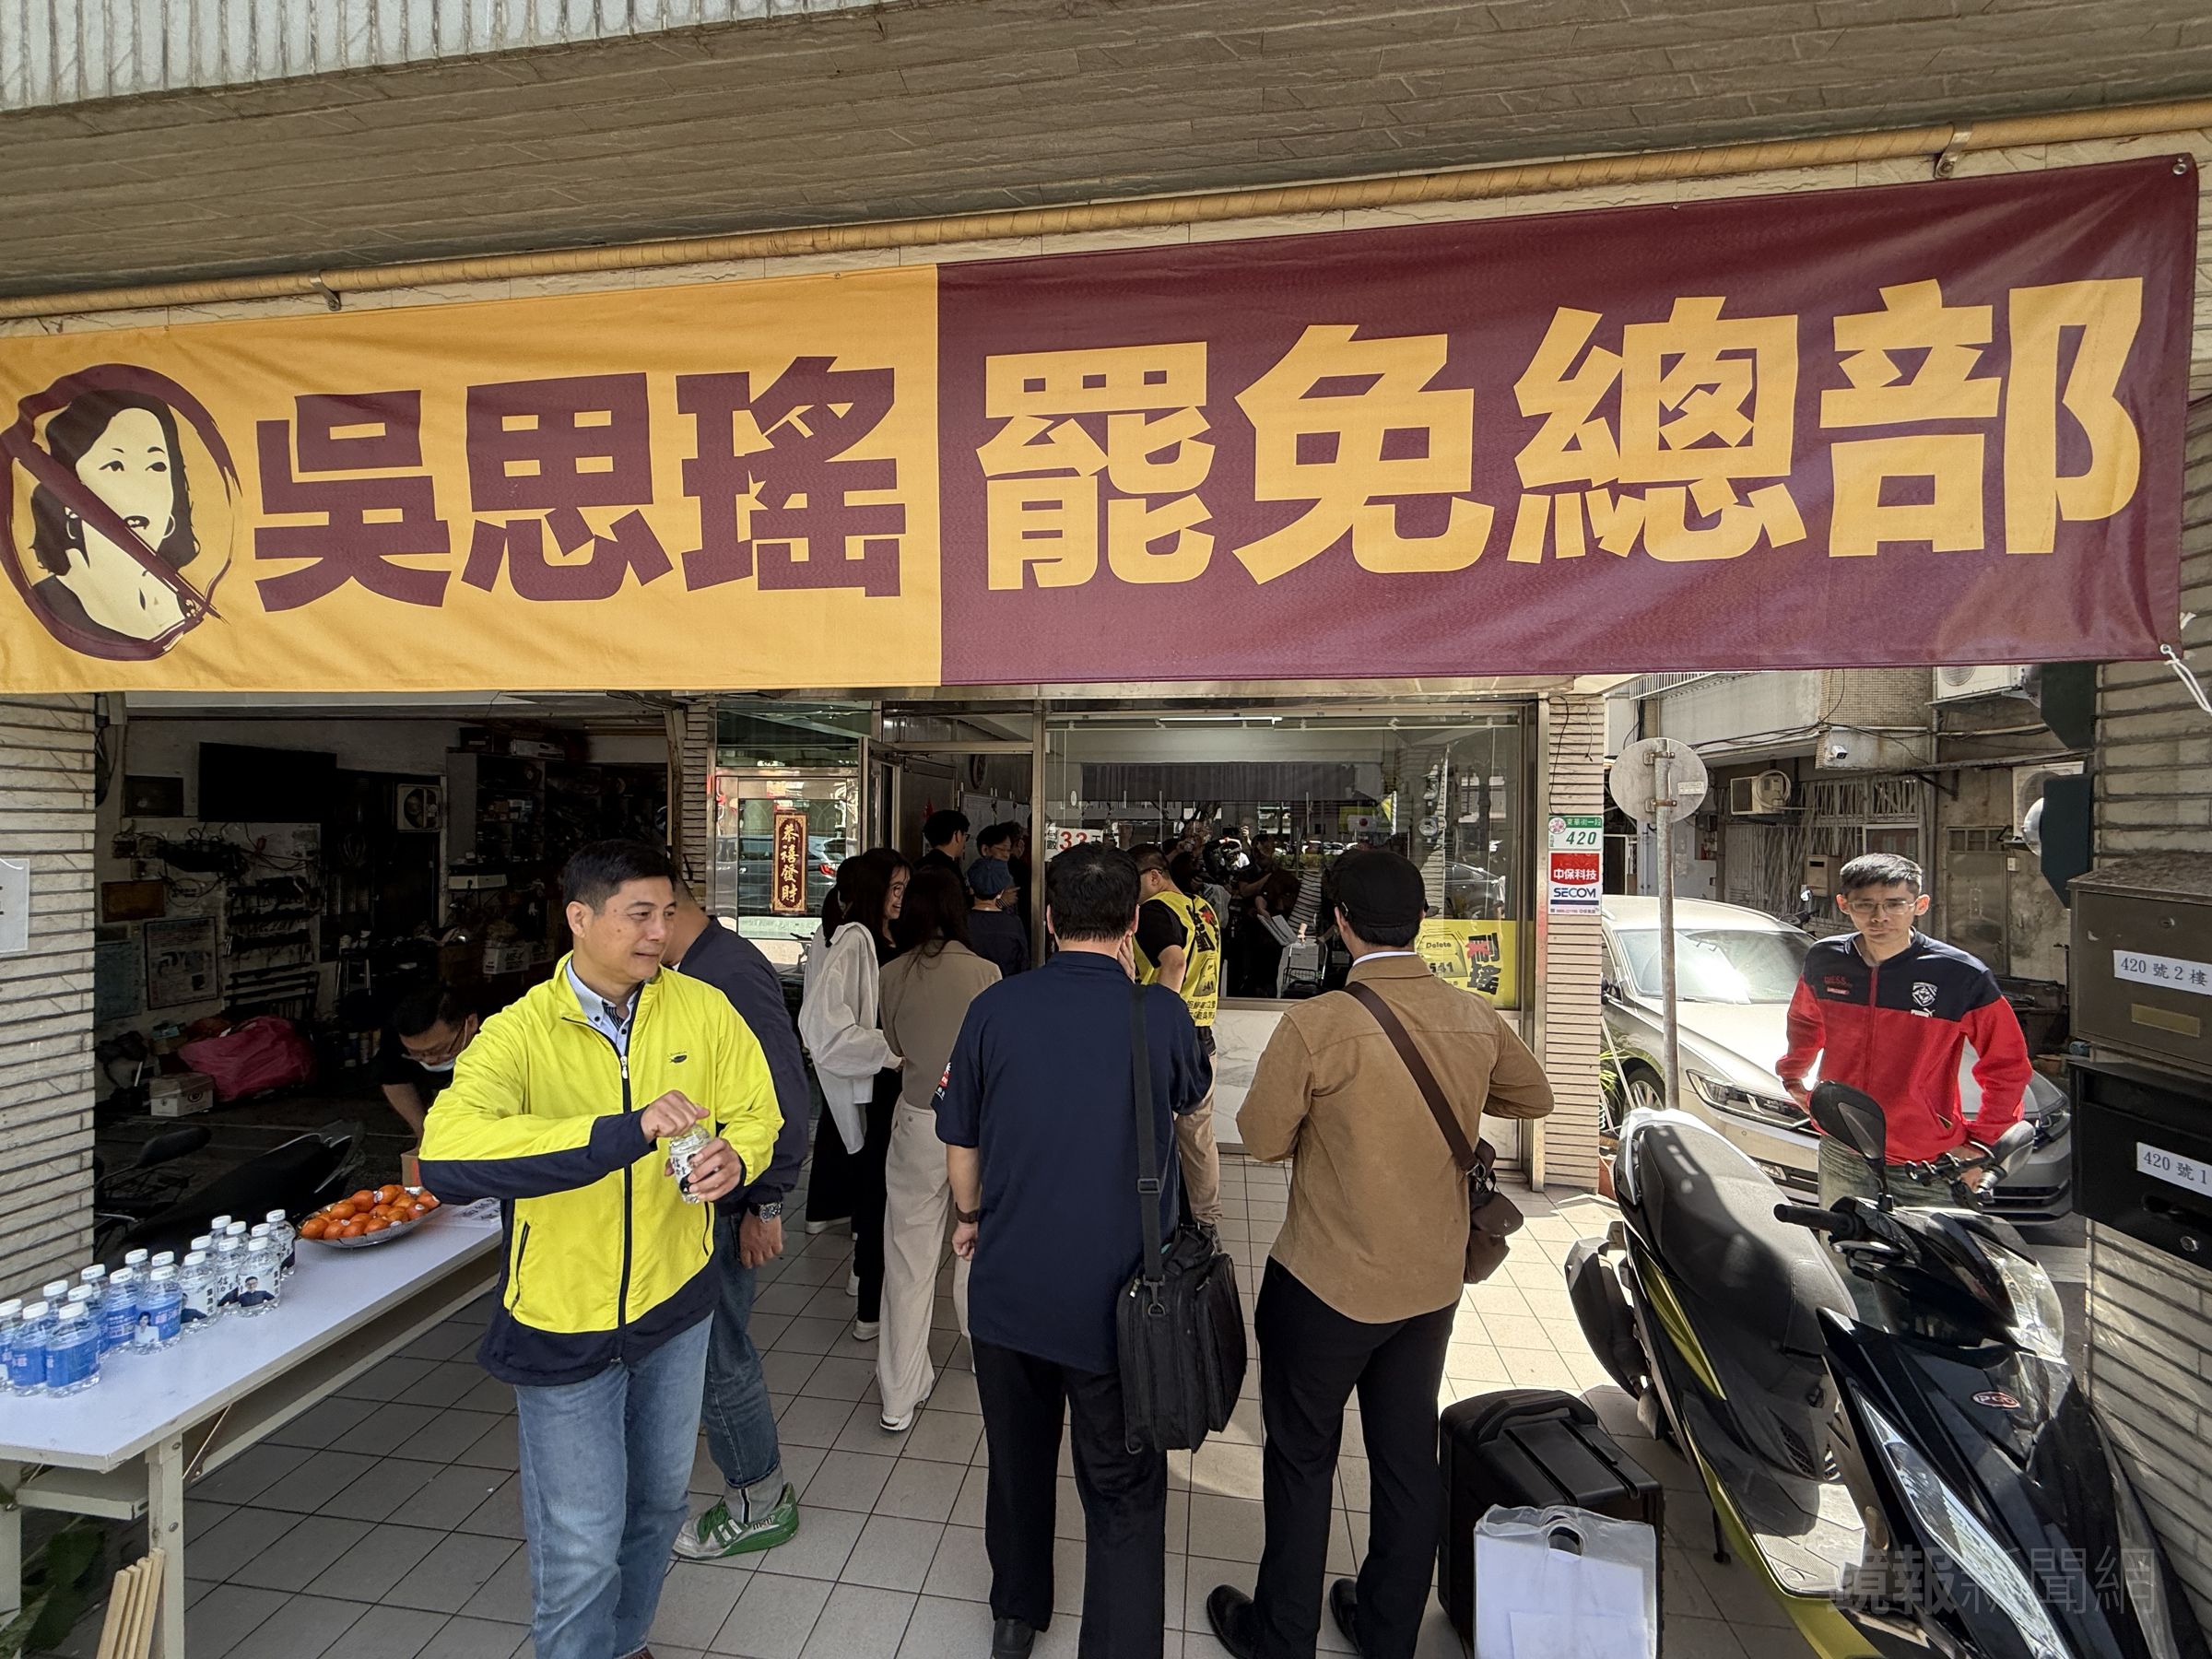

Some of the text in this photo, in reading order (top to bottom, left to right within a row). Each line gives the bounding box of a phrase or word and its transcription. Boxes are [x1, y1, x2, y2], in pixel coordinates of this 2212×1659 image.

[254, 276, 2145, 612] 吳思瑤 罷免總部
[1566, 831, 1597, 845] 420
[780, 822, 800, 903] 恭禧發財
[1553, 868, 1597, 881] 中保科技
[1553, 888, 1596, 899] SECOM
[1425, 941, 1453, 949] Delete
